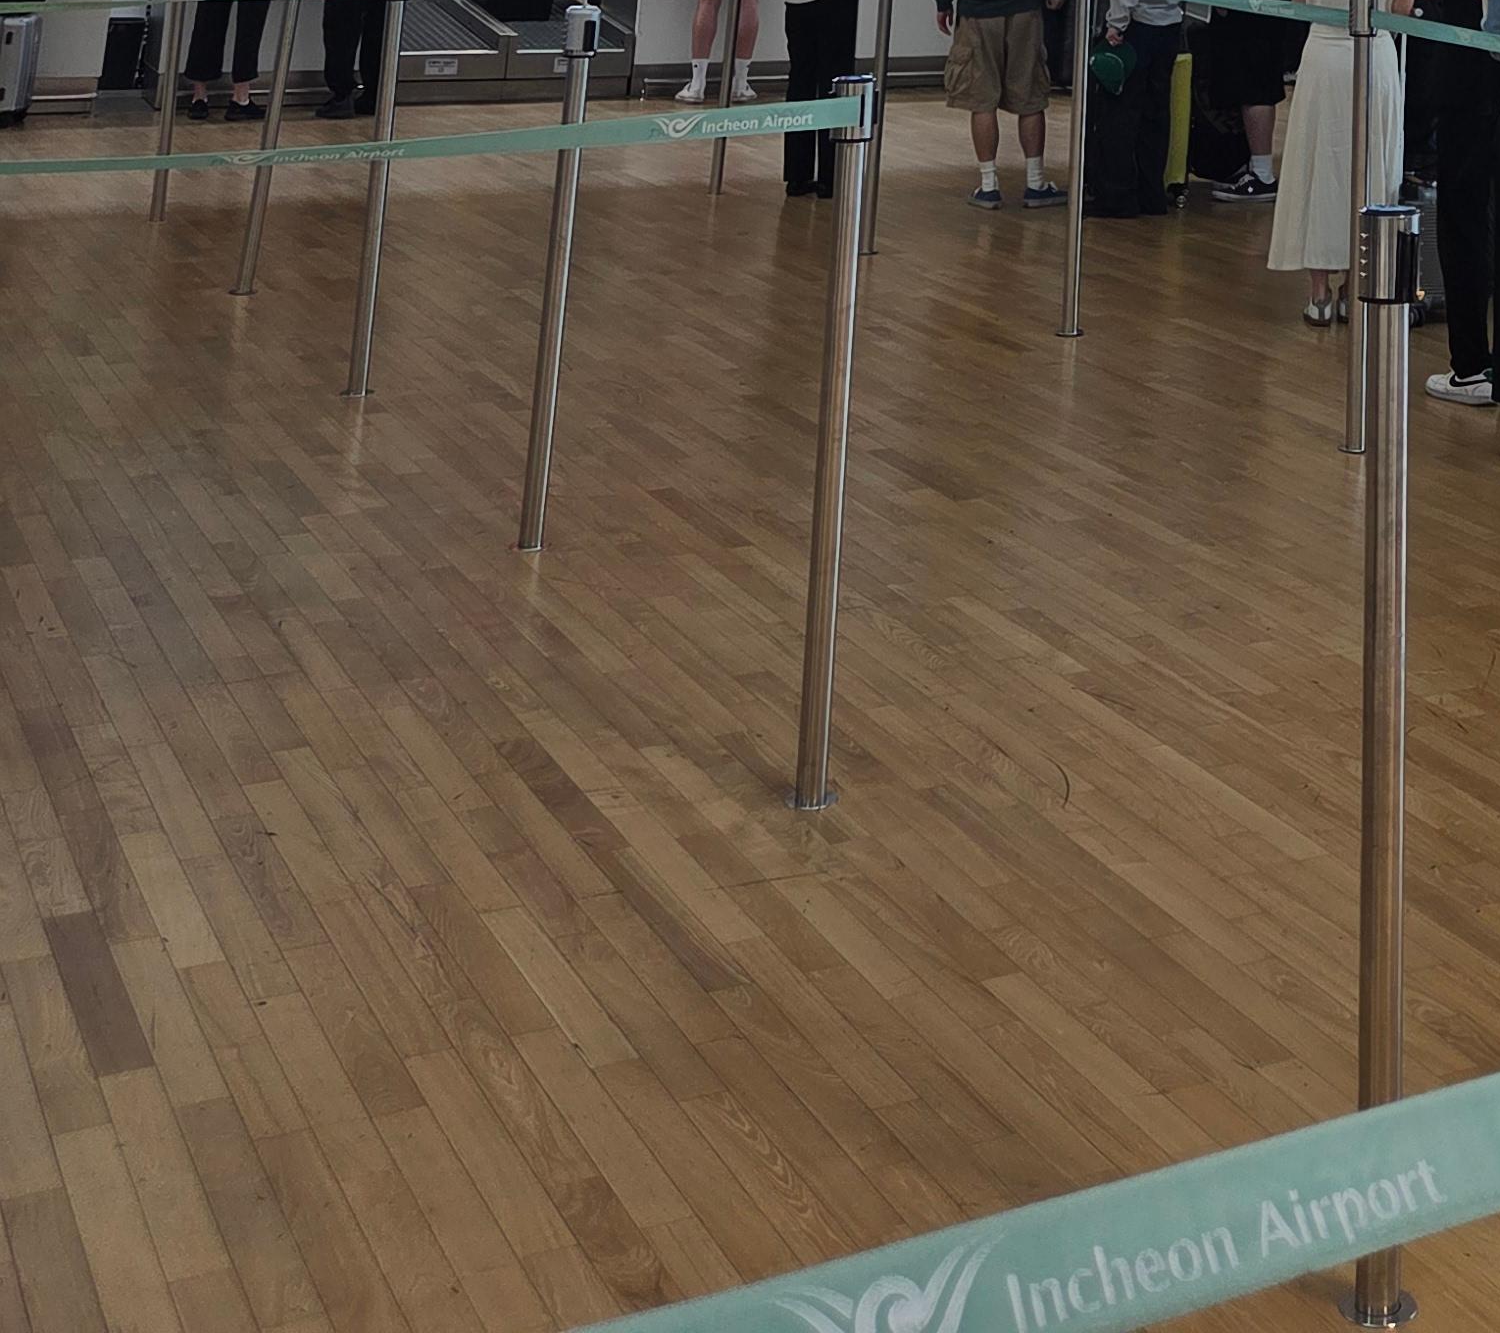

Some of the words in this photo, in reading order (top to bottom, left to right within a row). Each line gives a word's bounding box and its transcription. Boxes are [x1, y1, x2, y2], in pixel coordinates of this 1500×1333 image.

[702, 118, 759, 133] Incheon
[762, 114, 813, 129] Airport
[273, 152, 341, 163] Incheon
[345, 147, 404, 160] Airport
[1006, 1221, 1240, 1331] Incheon
[1257, 1158, 1447, 1260] Airport
